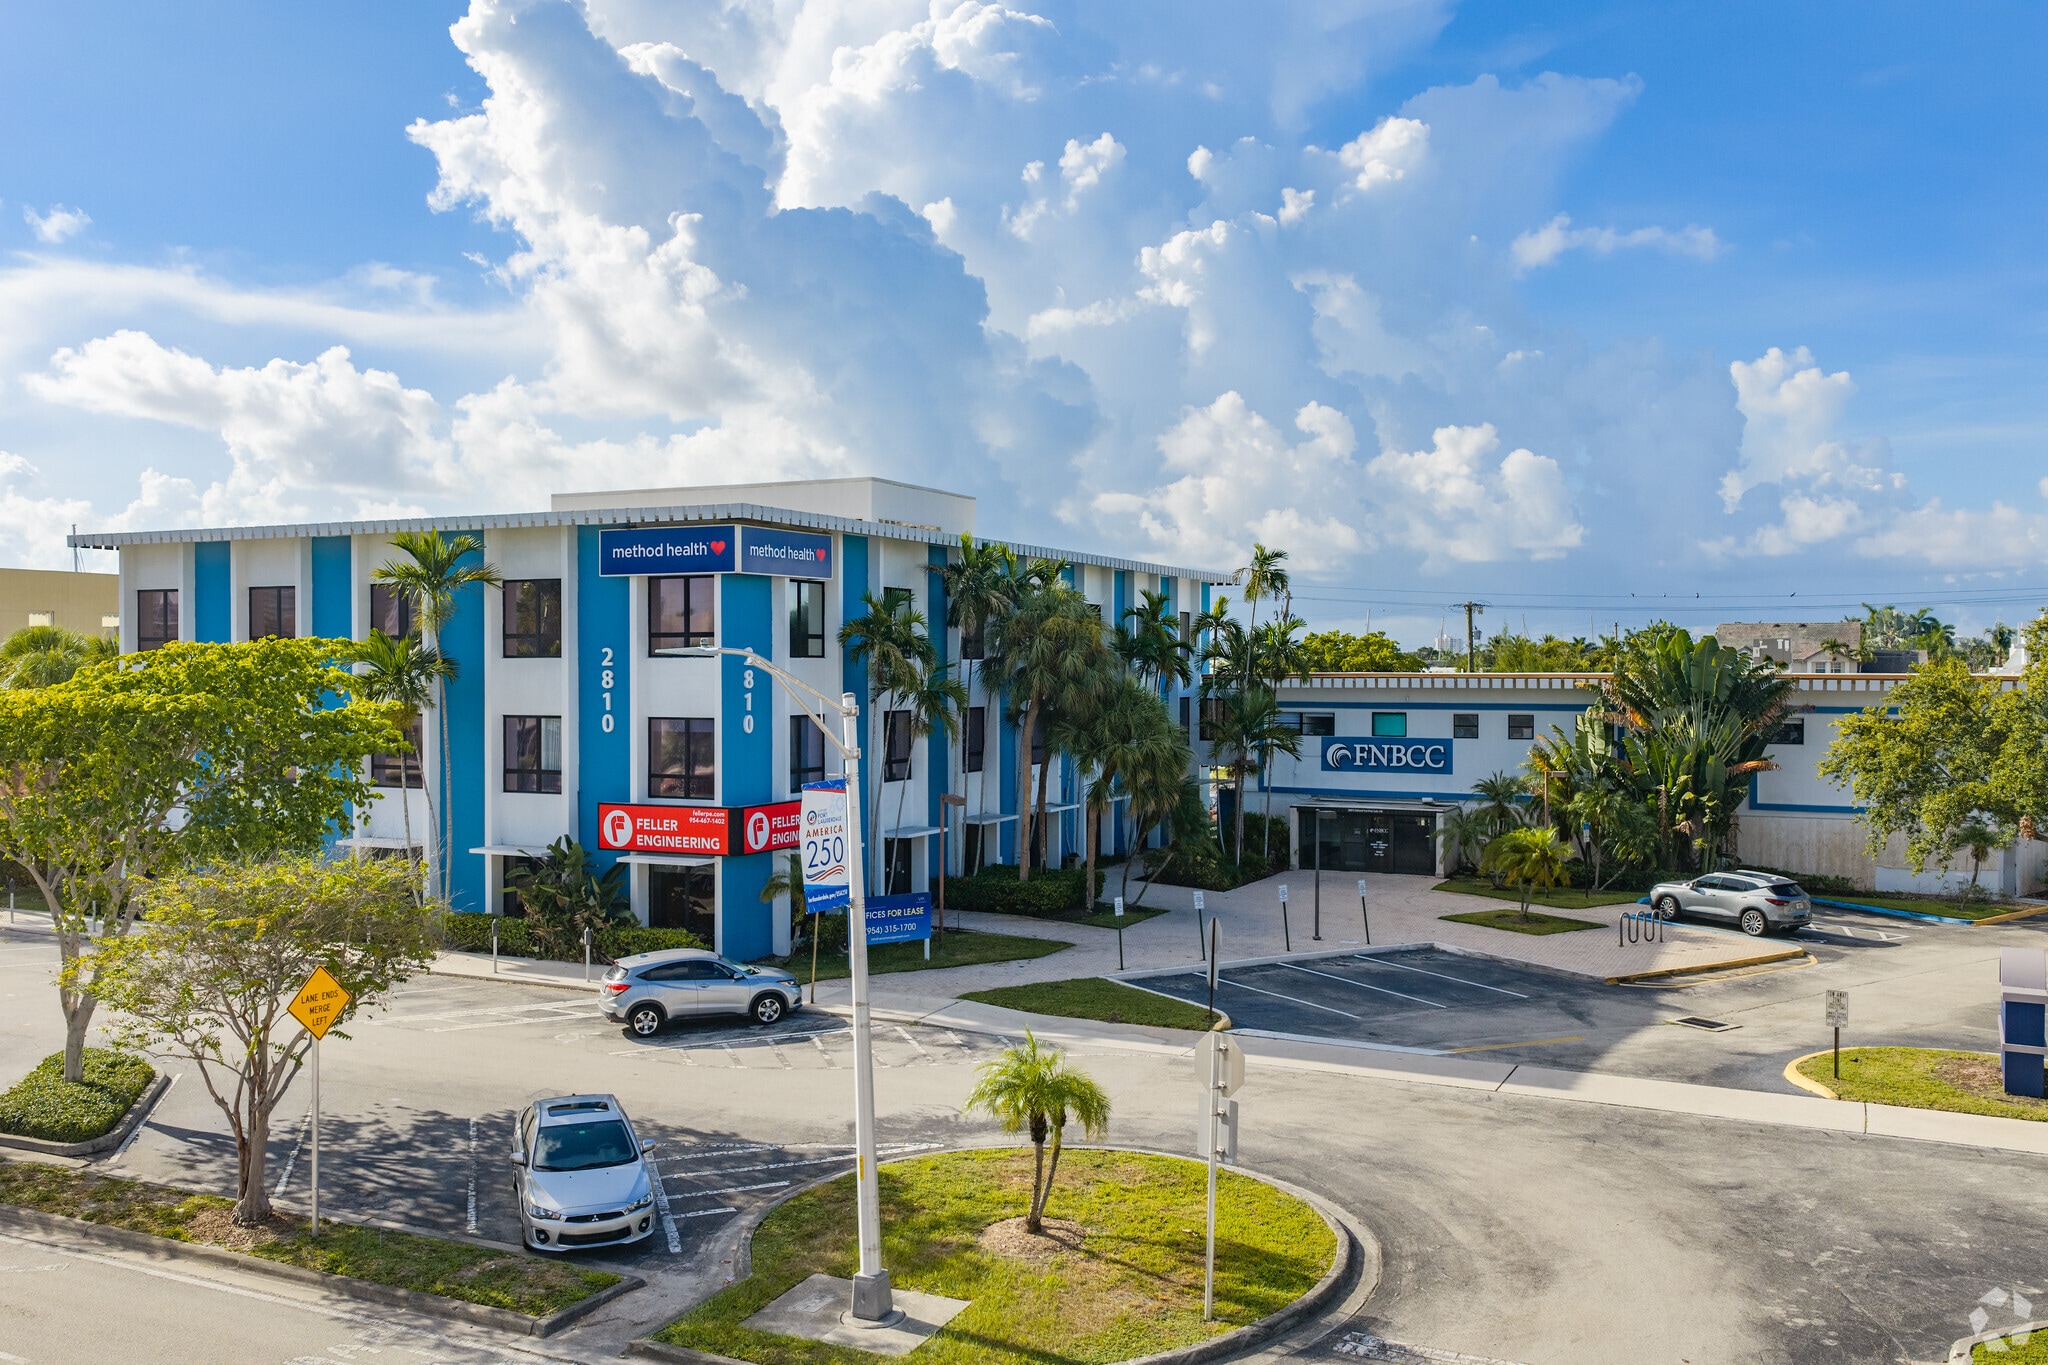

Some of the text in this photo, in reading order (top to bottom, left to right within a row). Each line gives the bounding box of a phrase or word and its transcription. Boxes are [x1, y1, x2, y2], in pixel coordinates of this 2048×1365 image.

[612, 542, 708, 558] method health
[750, 544, 815, 562] method health
[601, 647, 615, 733] 2810
[1353, 744, 1445, 768] FNBCC
[689, 817, 725, 825] 954-467-1402
[692, 810, 725, 818] fellerpe.com
[636, 818, 679, 831] FELLER
[806, 824, 843, 839] AMERICA
[636, 834, 720, 850] ENGINEERING
[771, 829, 801, 845] ENGIN
[806, 836, 844, 869] 250
[887, 909, 902, 918] FOR
[903, 907, 924, 916] LEASE
[884, 923, 917, 934] 315-1700
[301, 990, 338, 1004] LANE ENDS
[310, 1004, 330, 1014] MERGE
[312, 1016, 327, 1026] LEFT
